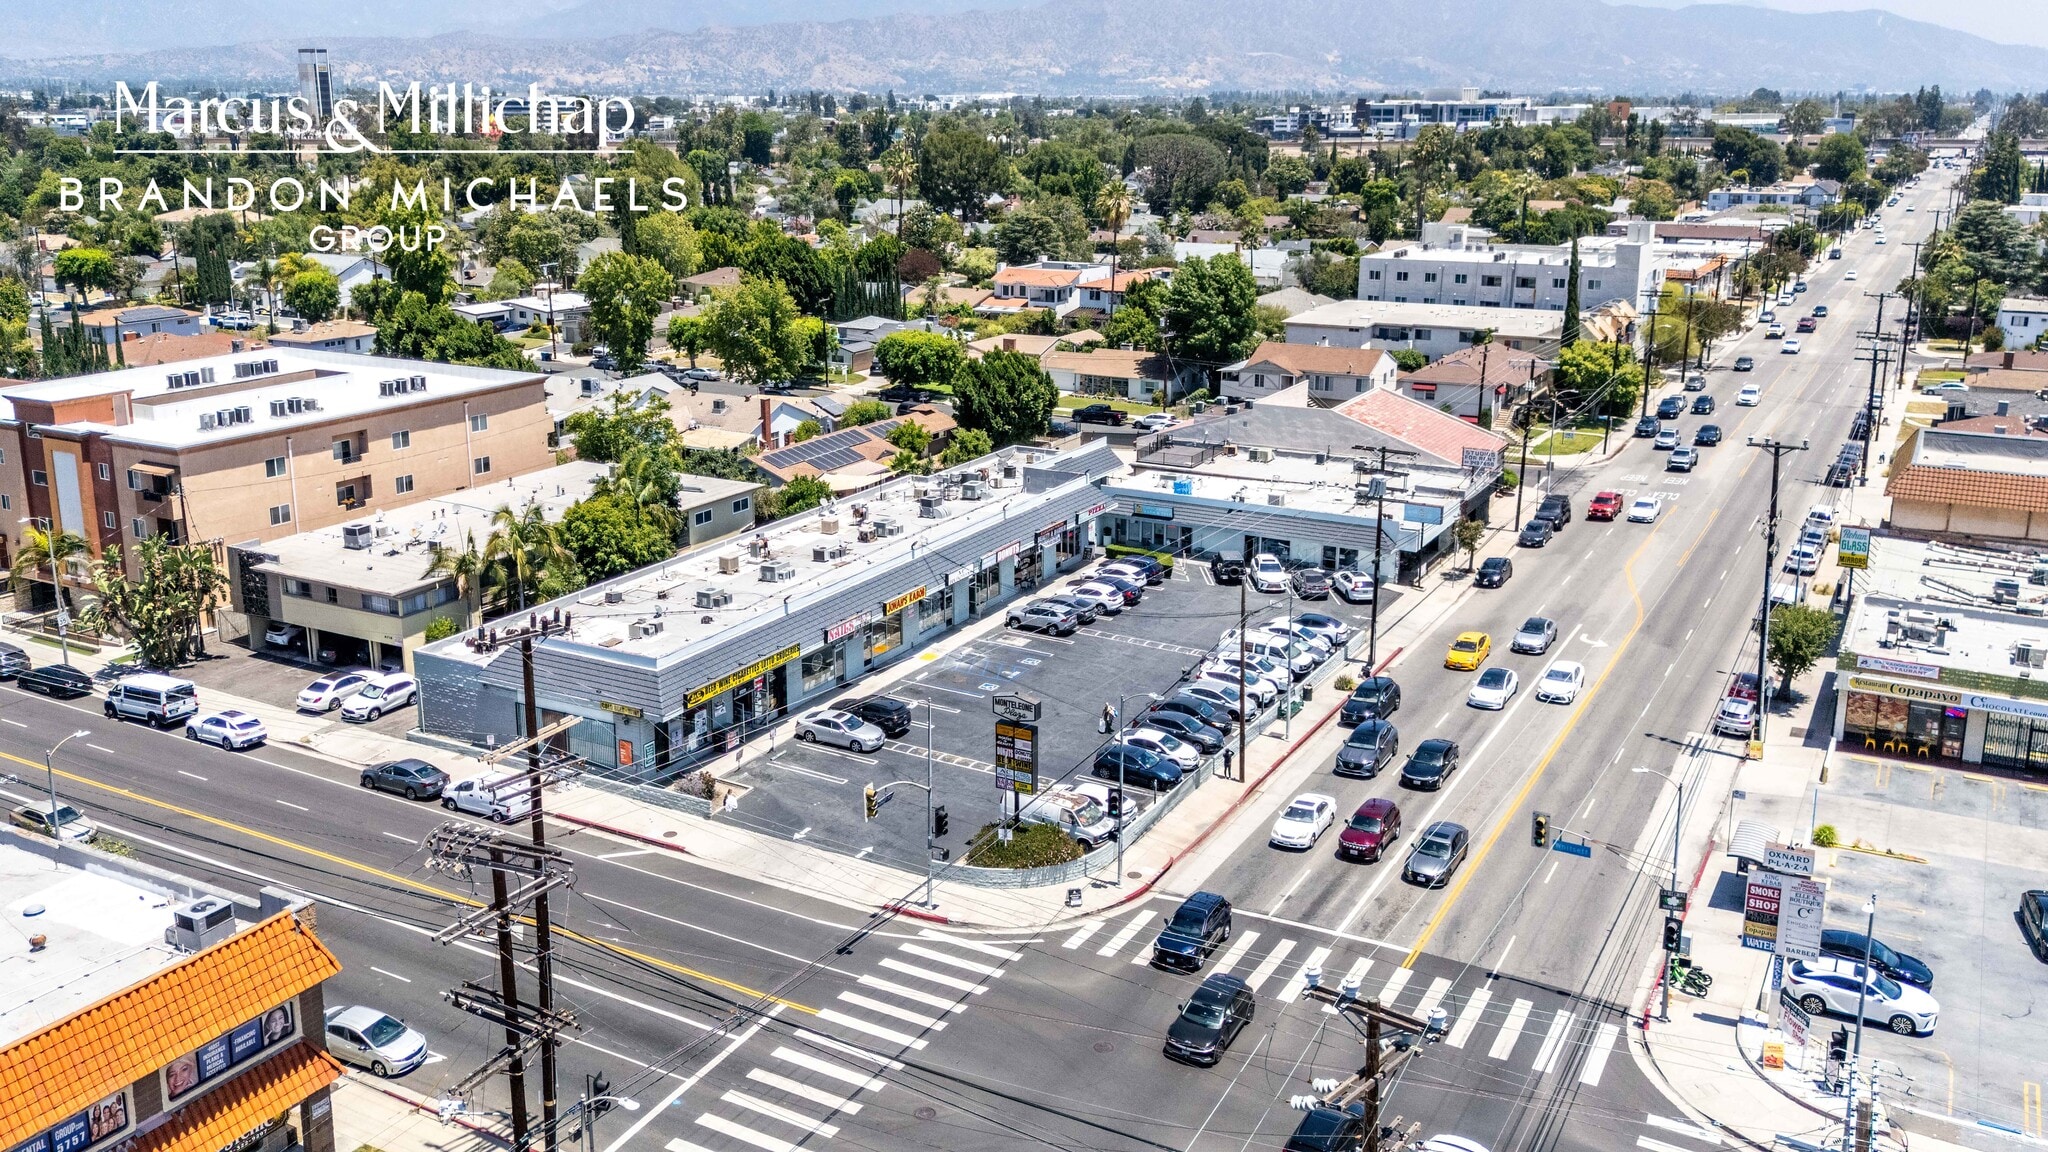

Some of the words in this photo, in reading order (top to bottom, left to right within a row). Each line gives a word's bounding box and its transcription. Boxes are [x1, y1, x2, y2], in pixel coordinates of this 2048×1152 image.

[1088, 504, 1106, 516] PIZZA
[1841, 539, 1868, 553] GLASS
[1840, 555, 1866, 565] MIRRORS
[828, 621, 855, 641] NAILS
[1881, 665, 1927, 675] RESTAURANT
[1855, 678, 1888, 689] Restaurant
[1890, 683, 1958, 702] Copapayo
[994, 698, 1034, 713] MONTELEONE
[1001, 707, 1028, 720] Plaza
[1769, 851, 1810, 864] OXNARD
[1761, 878, 1782, 887] KEBAB
[1750, 885, 1780, 899] SMOKE
[1795, 892, 1811, 900] ELLE
[1749, 898, 1778, 911] SHOP
[1789, 896, 1822, 908] BOUTIQUE
[1746, 937, 1776, 951] WATER
[1785, 946, 1816, 957] BARBER
[1783, 1010, 1805, 1035] Flower
[1791, 1029, 1806, 1046] Shop
[202, 1044, 226, 1061] INSURANCE
[235, 1037, 256, 1054] AVAILABLE
[206, 1054, 220, 1066] PLANS
[206, 1058, 224, 1072] MEDICAL
[205, 1063, 227, 1078] ACCEPTED
[56, 1131, 86, 1152] 5757
